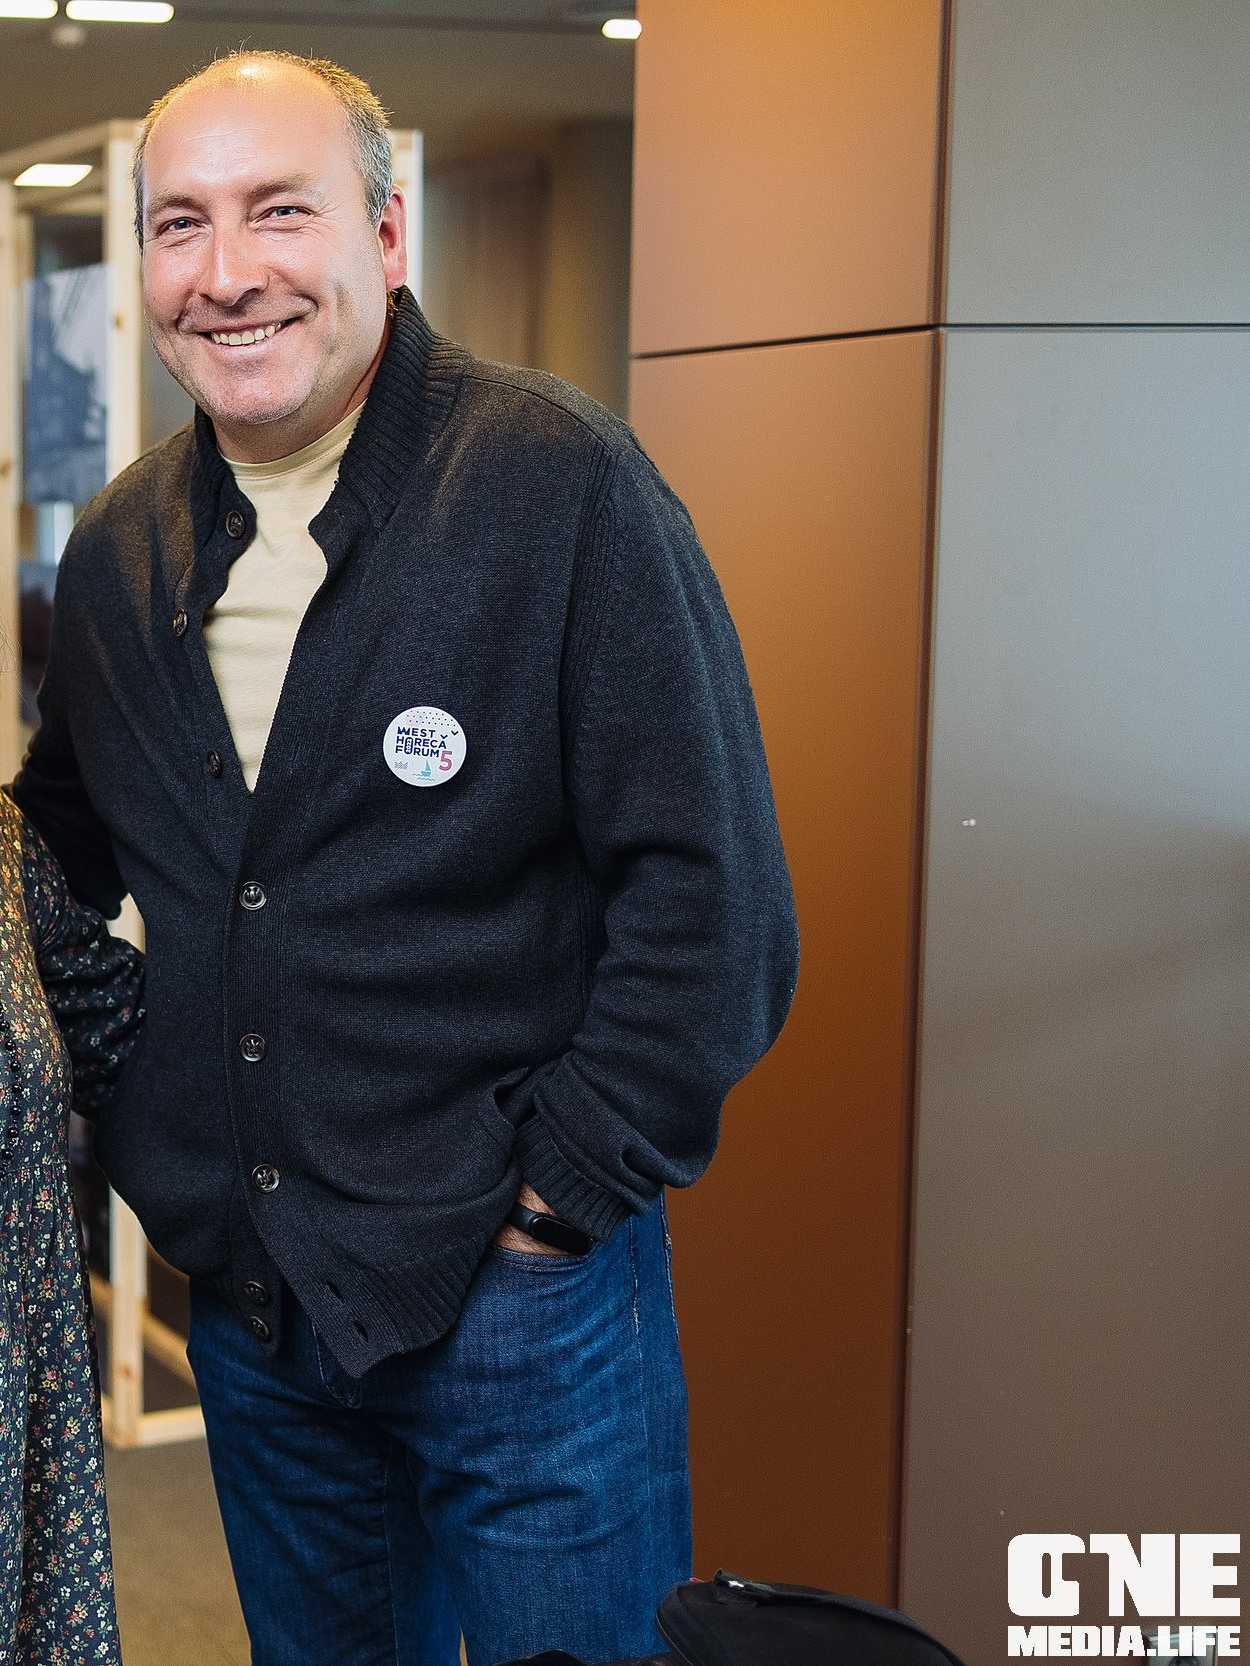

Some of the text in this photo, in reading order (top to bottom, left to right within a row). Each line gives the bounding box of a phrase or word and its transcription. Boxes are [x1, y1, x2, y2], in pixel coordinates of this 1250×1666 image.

[397, 726, 436, 738] WEST
[396, 736, 447, 749] HORECA
[395, 744, 440, 758] FORUM
[438, 750, 453, 771] 5
